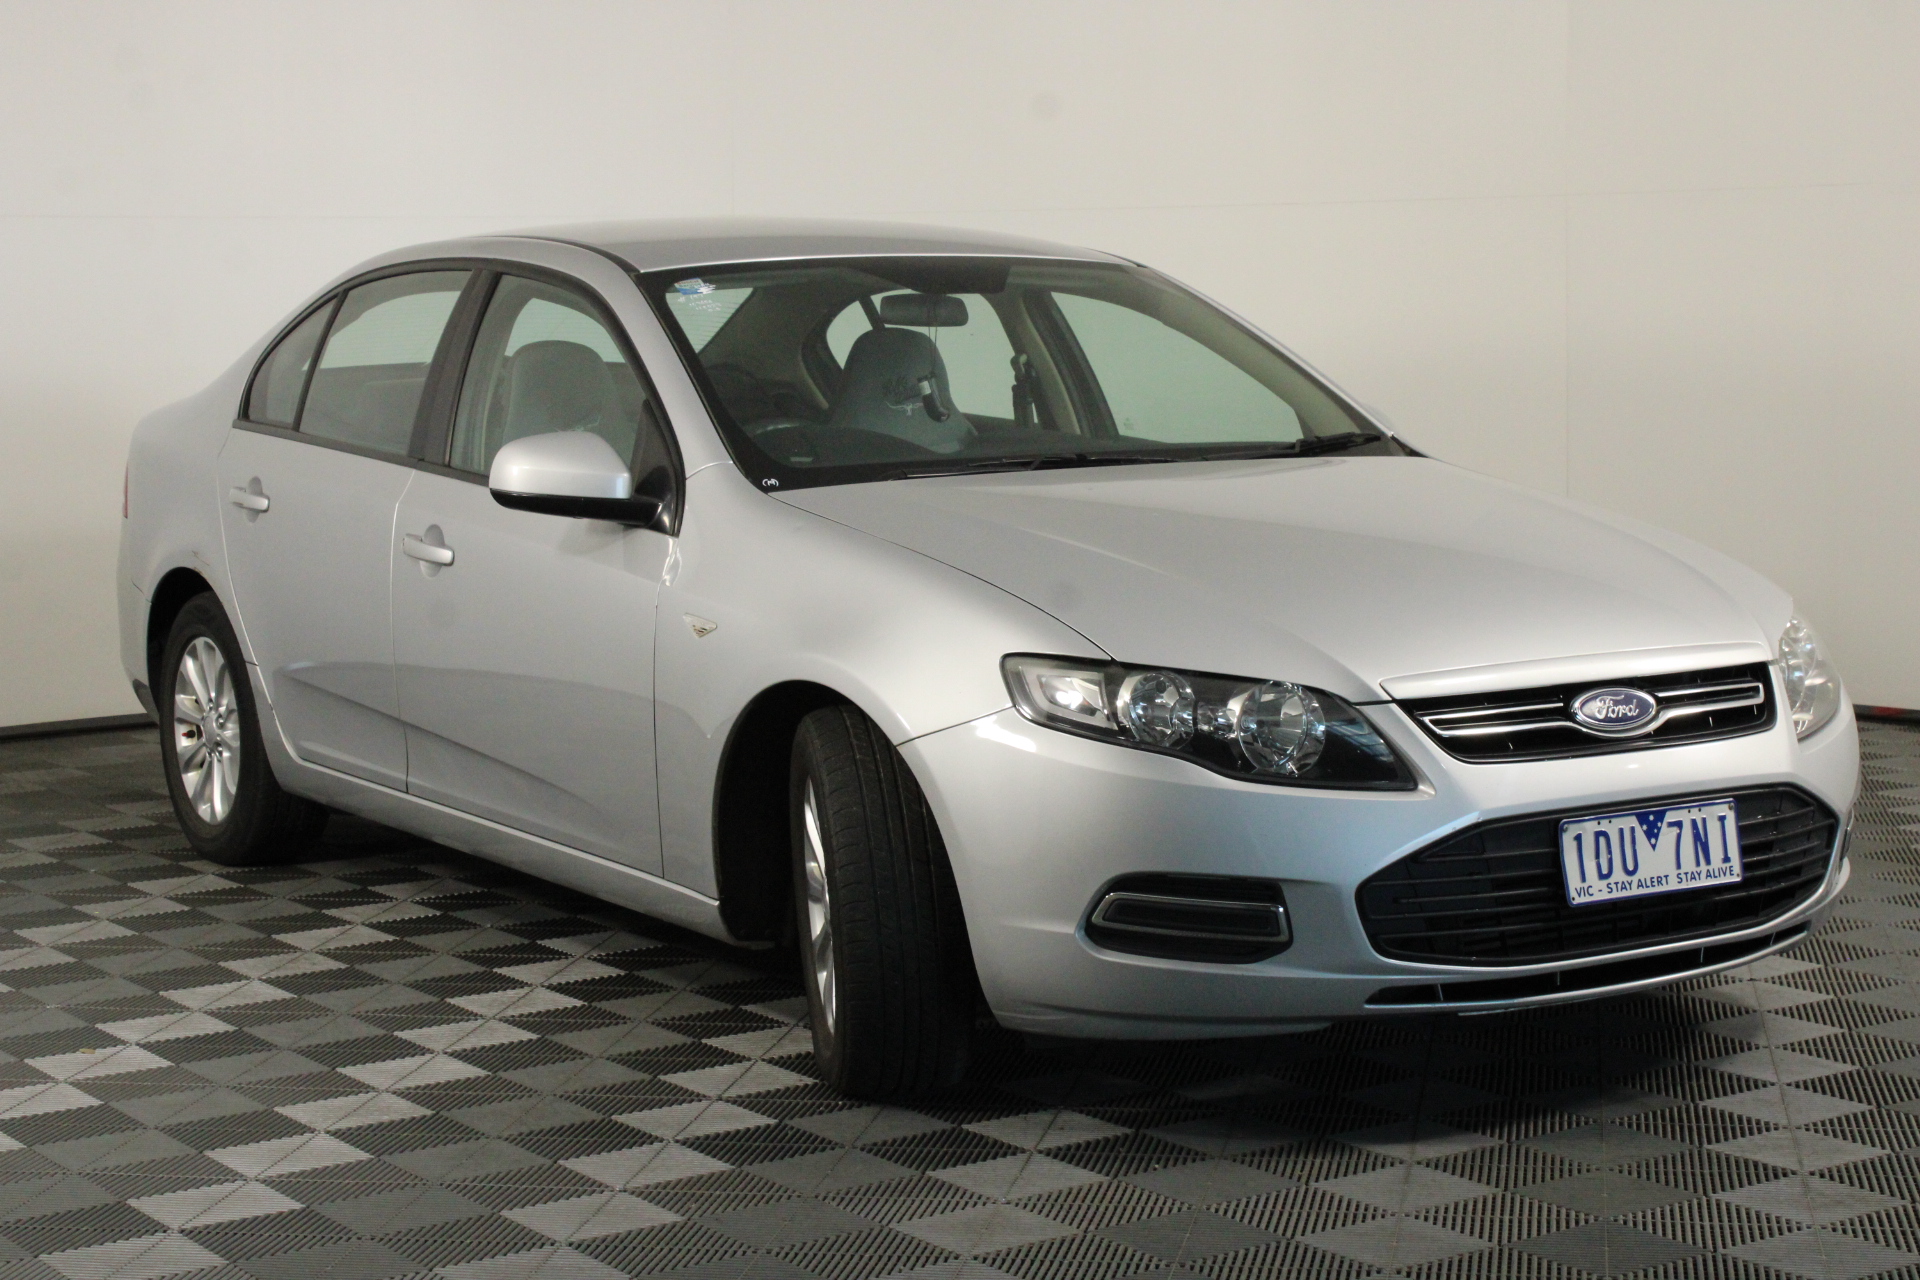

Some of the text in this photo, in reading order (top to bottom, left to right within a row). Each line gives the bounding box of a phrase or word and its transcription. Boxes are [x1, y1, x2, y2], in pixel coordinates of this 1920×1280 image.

[1595, 694, 1639, 720] Ford
[1573, 824, 1639, 883] 1DU
[1575, 885, 1594, 899] VIC
[1606, 880, 1633, 894] STAY
[1636, 874, 1669, 890] ALERT
[1676, 870, 1703, 884] STAY
[1705, 865, 1735, 880] ALIVE
